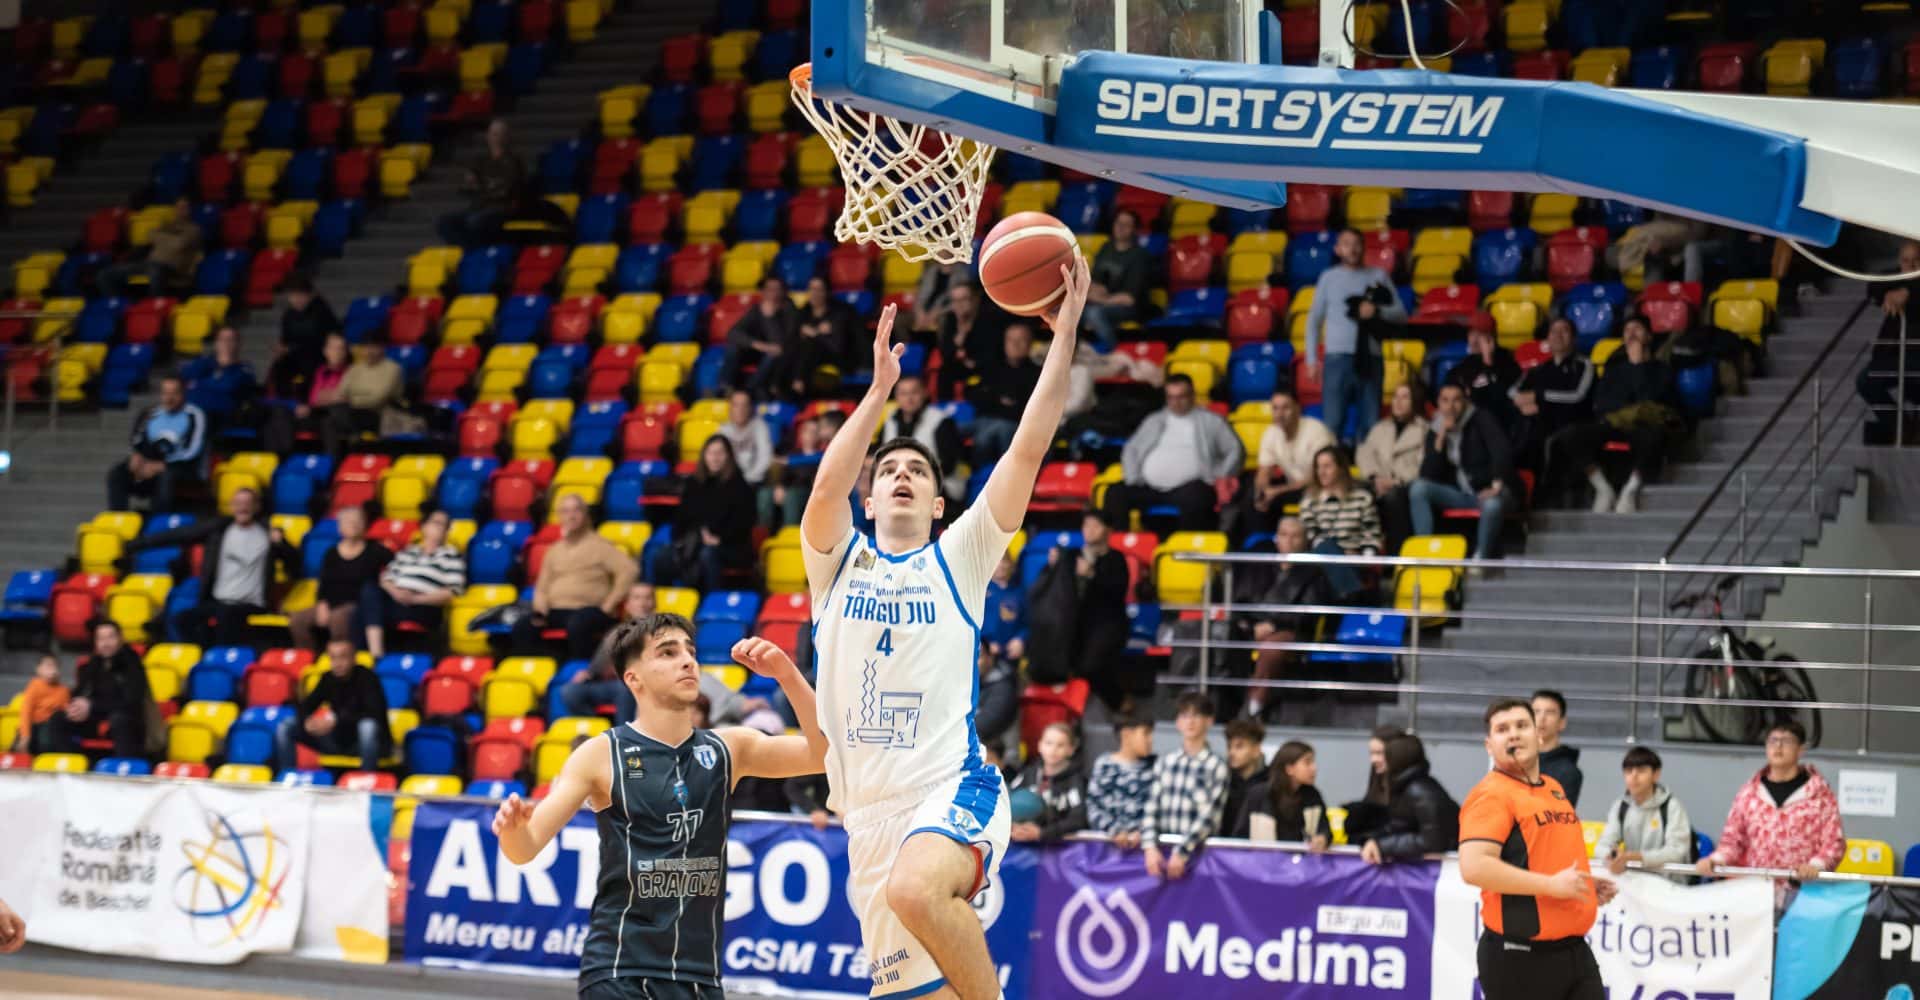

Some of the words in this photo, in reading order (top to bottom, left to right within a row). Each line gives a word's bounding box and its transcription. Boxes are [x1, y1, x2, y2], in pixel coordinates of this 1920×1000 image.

[1096, 79, 1504, 148] SPORTSYSTEM
[843, 590, 900, 625] TÂRGU
[905, 601, 936, 625] JIU
[876, 628, 894, 656] 4
[666, 808, 704, 842] 77
[59, 890, 80, 909] de
[637, 871, 721, 898] CRAIOVA
[424, 911, 537, 952] Mereu
[725, 935, 817, 975] CSM
[882, 948, 910, 968] LOCAL
[1164, 920, 1407, 990] Medima
